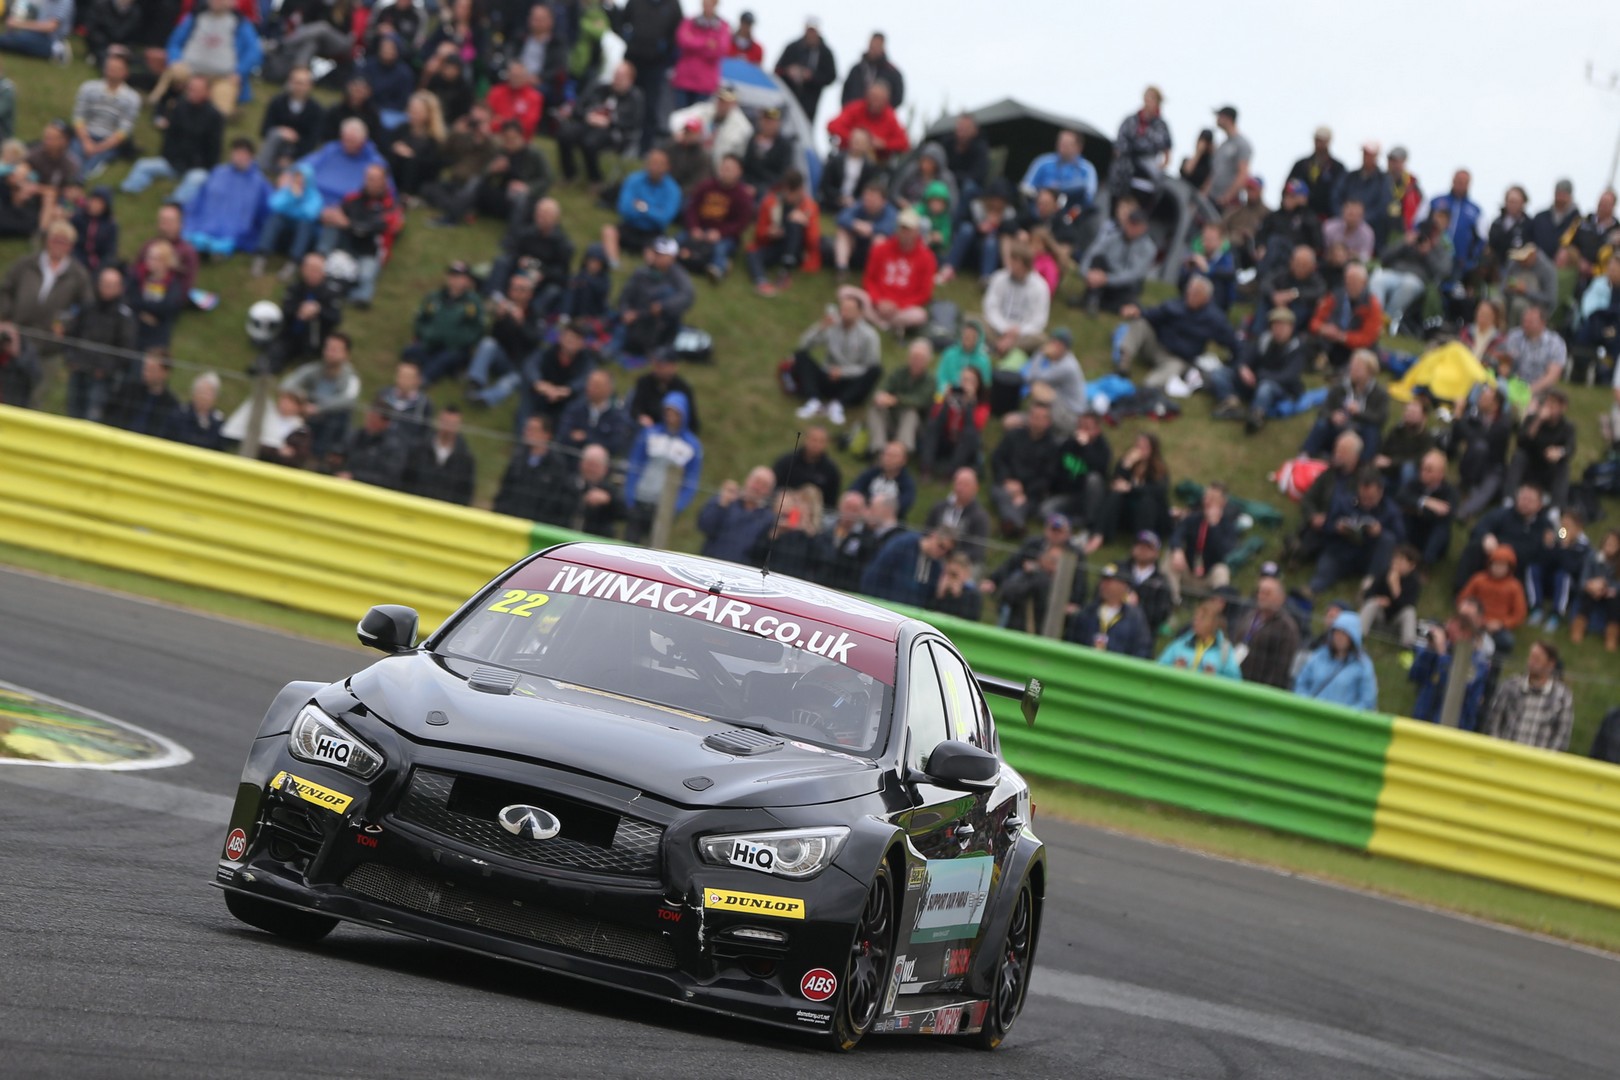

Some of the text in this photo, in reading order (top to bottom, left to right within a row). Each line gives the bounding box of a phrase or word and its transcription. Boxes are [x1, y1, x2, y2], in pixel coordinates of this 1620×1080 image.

[487, 589, 550, 618] 22
[547, 566, 857, 664] iWINACAR.co.uk
[316, 738, 350, 764] HiQ
[227, 835, 245, 853] ABS
[357, 834, 378, 848] TOW
[733, 843, 774, 870] HiQ
[724, 896, 799, 912] DUNLOP
[658, 909, 682, 922] TOW
[804, 975, 834, 993] ABS
